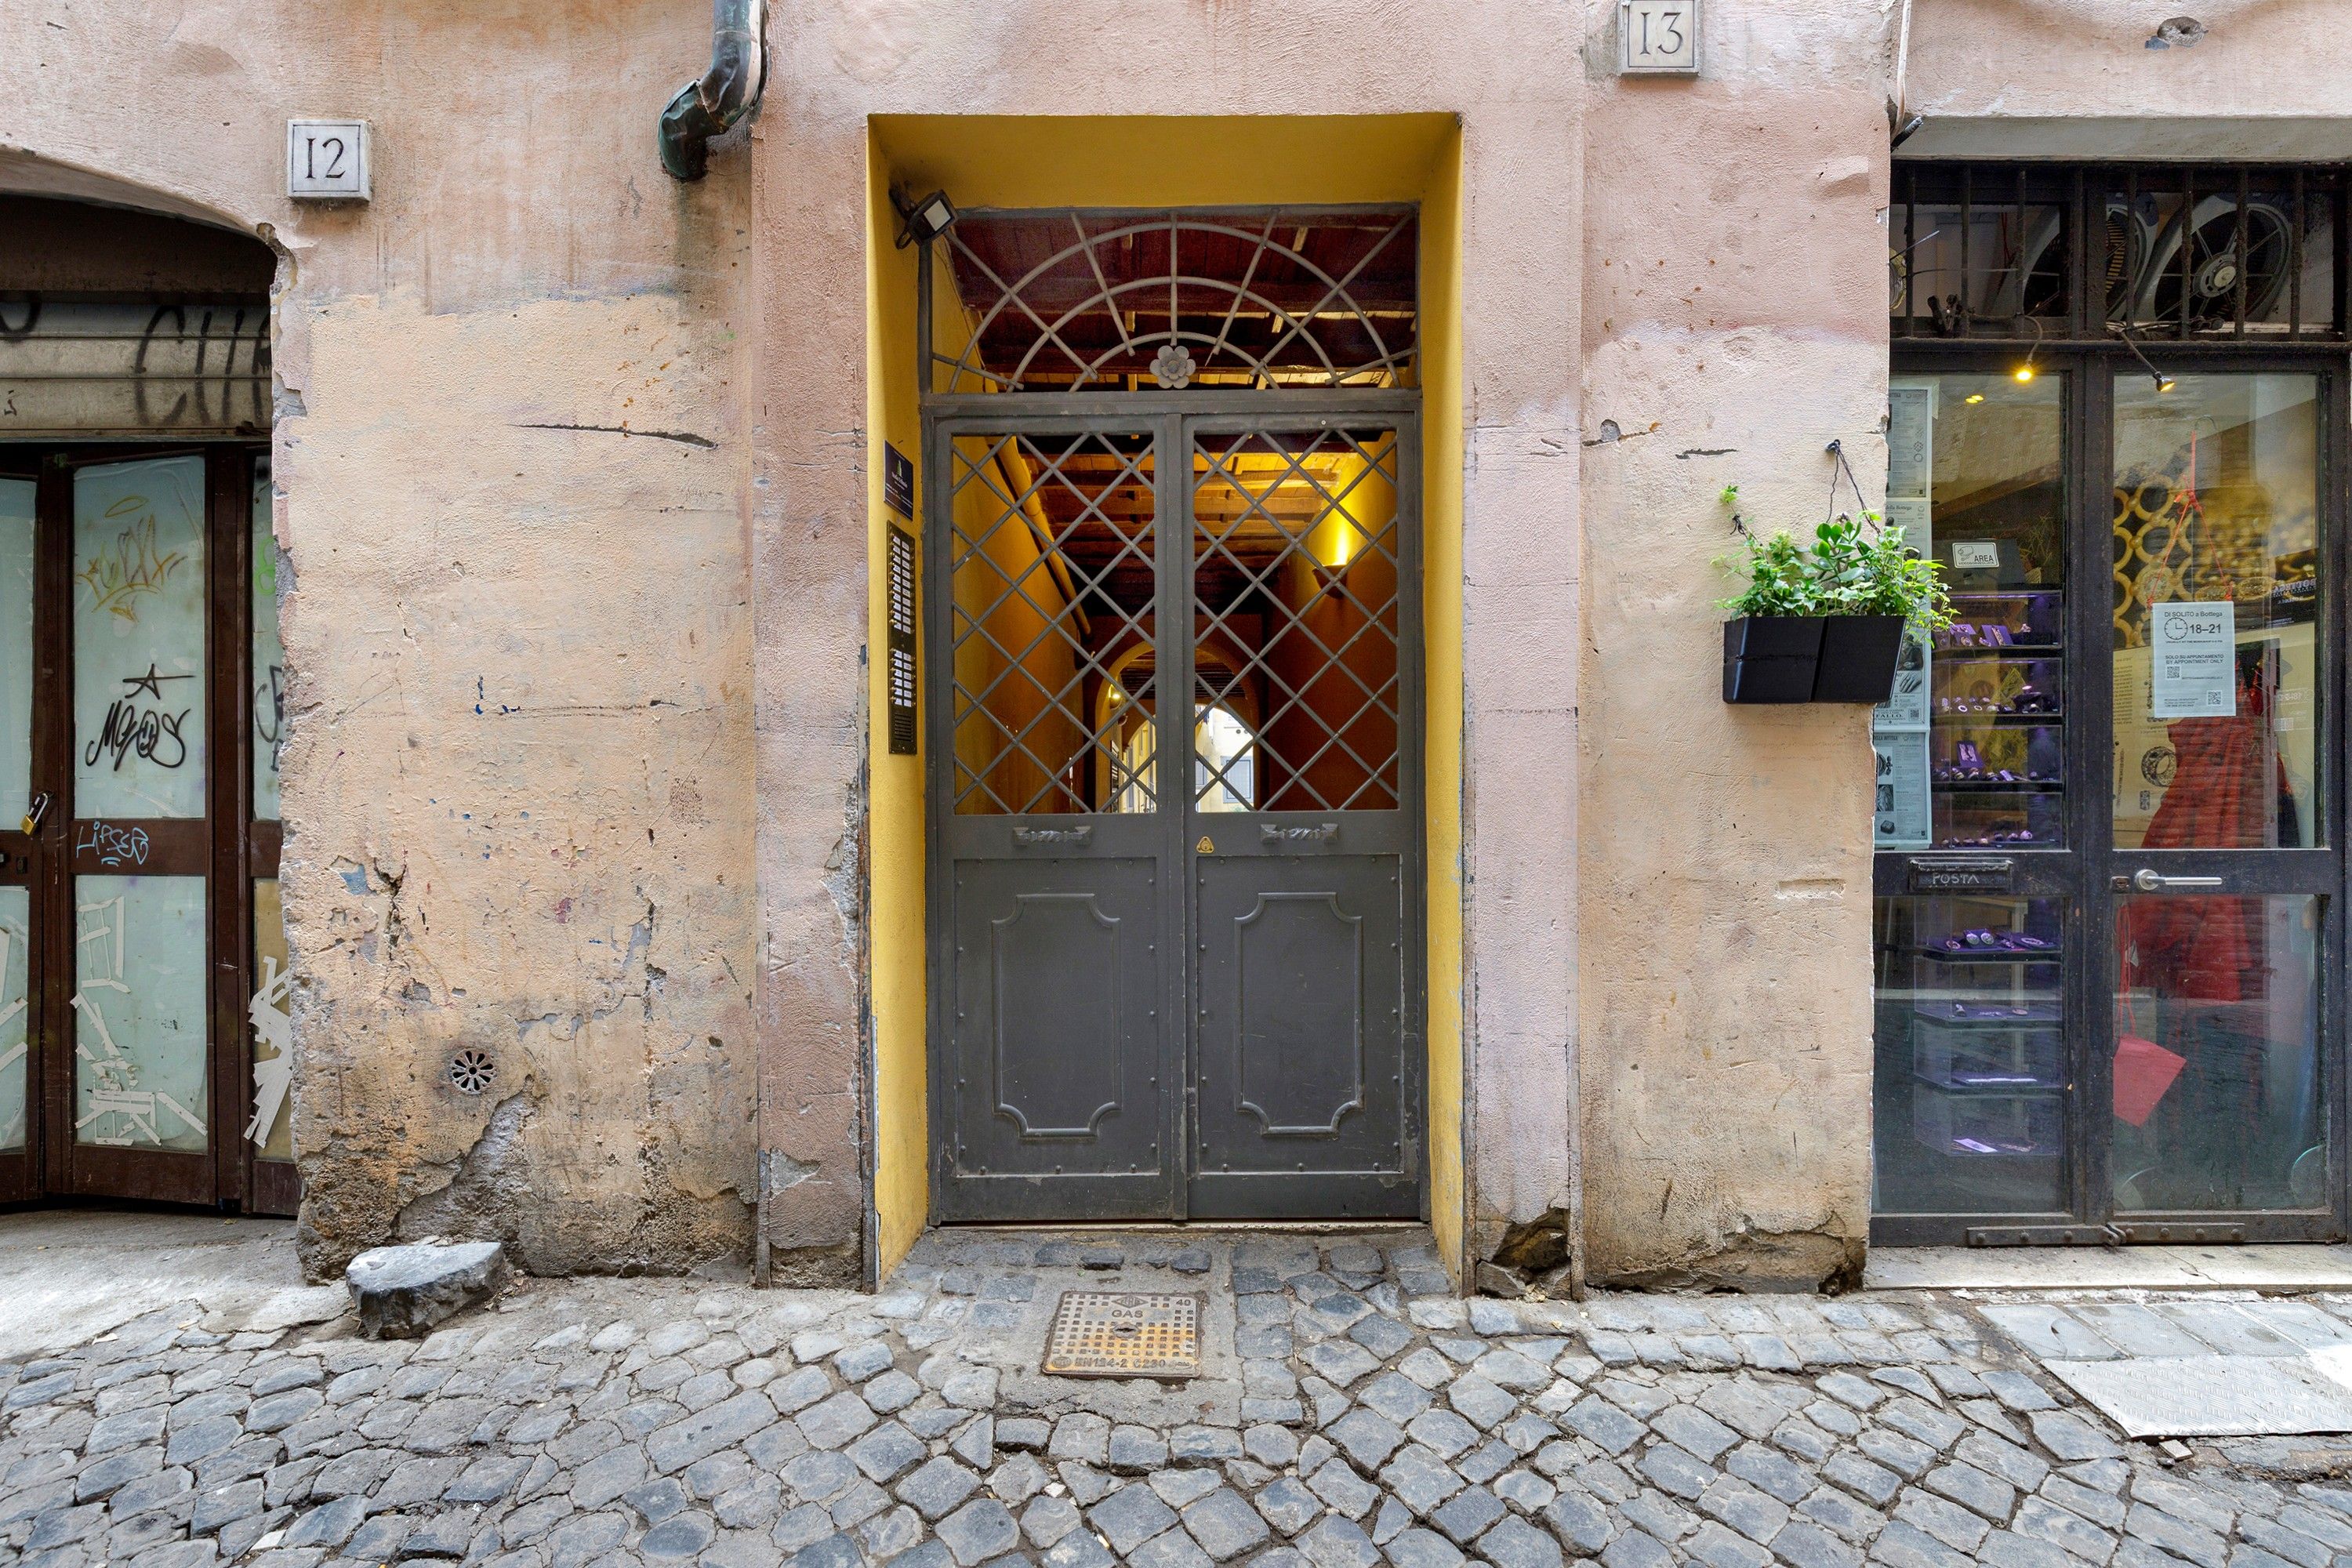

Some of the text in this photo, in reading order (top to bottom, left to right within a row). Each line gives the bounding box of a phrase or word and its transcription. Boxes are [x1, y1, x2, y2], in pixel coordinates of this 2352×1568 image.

[1639, 12, 1684, 56] 13
[305, 137, 346, 180] 12
[1932, 872, 1980, 884] POSTA
[1176, 1298, 1192, 1307] 40
[1111, 1309, 1144, 1319] GAS
